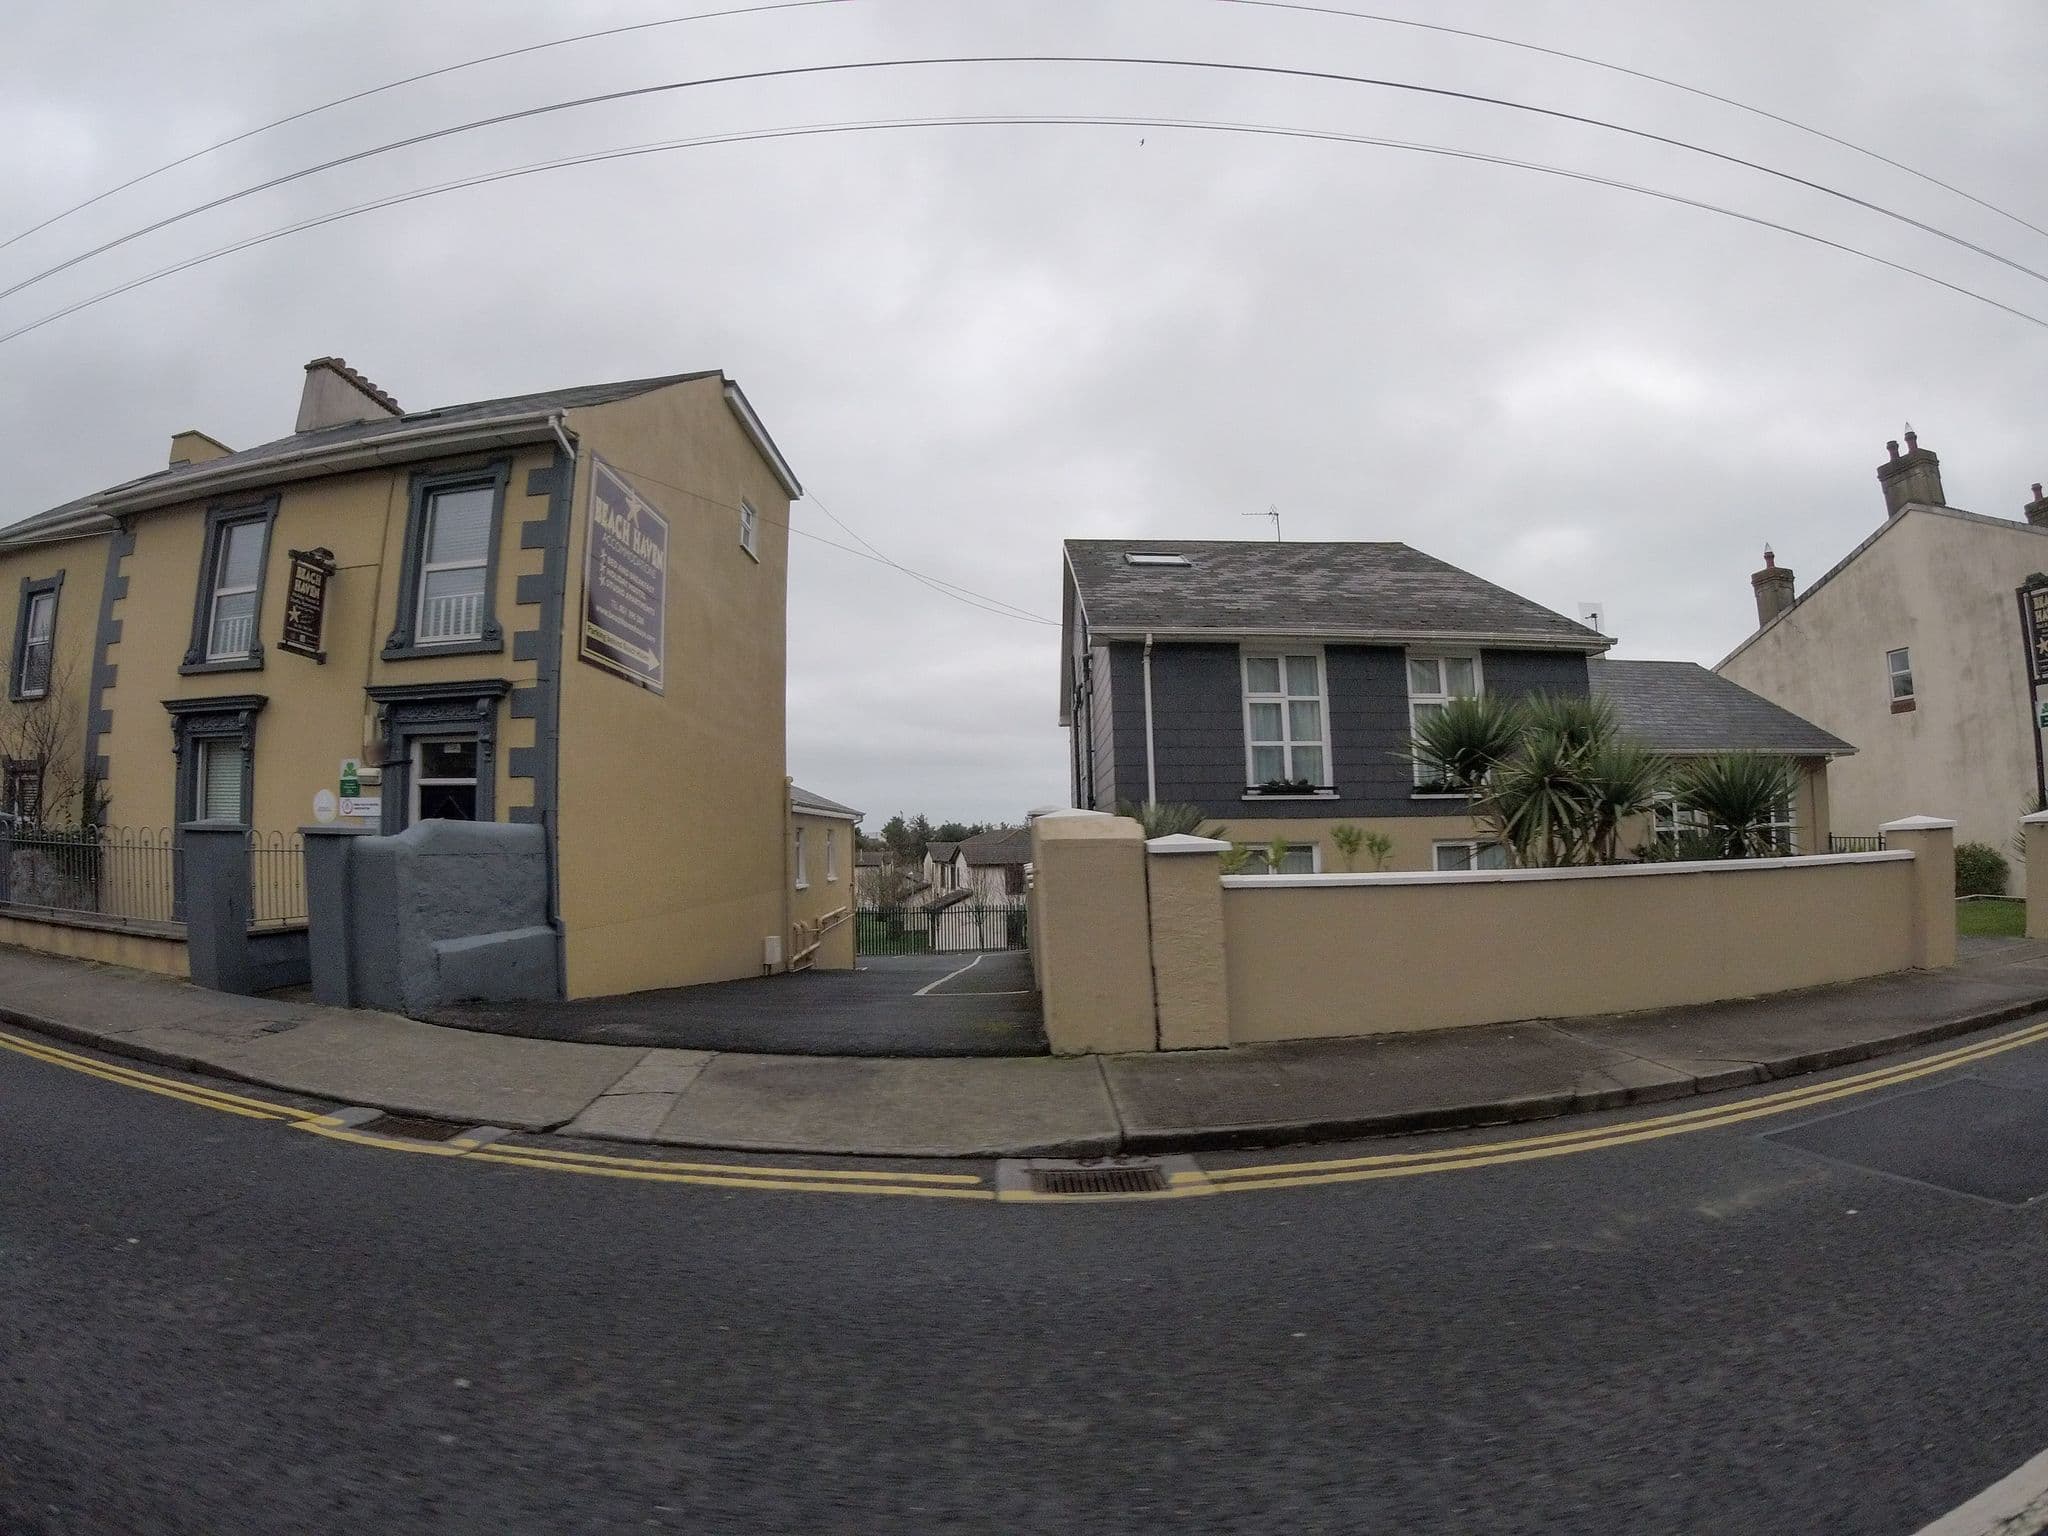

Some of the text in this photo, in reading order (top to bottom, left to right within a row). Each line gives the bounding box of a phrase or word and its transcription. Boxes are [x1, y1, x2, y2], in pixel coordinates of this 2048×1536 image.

[594, 496, 664, 571] BEACH HAVEN
[296, 566, 321, 586] BEACH
[294, 579, 320, 599] HAVEN
